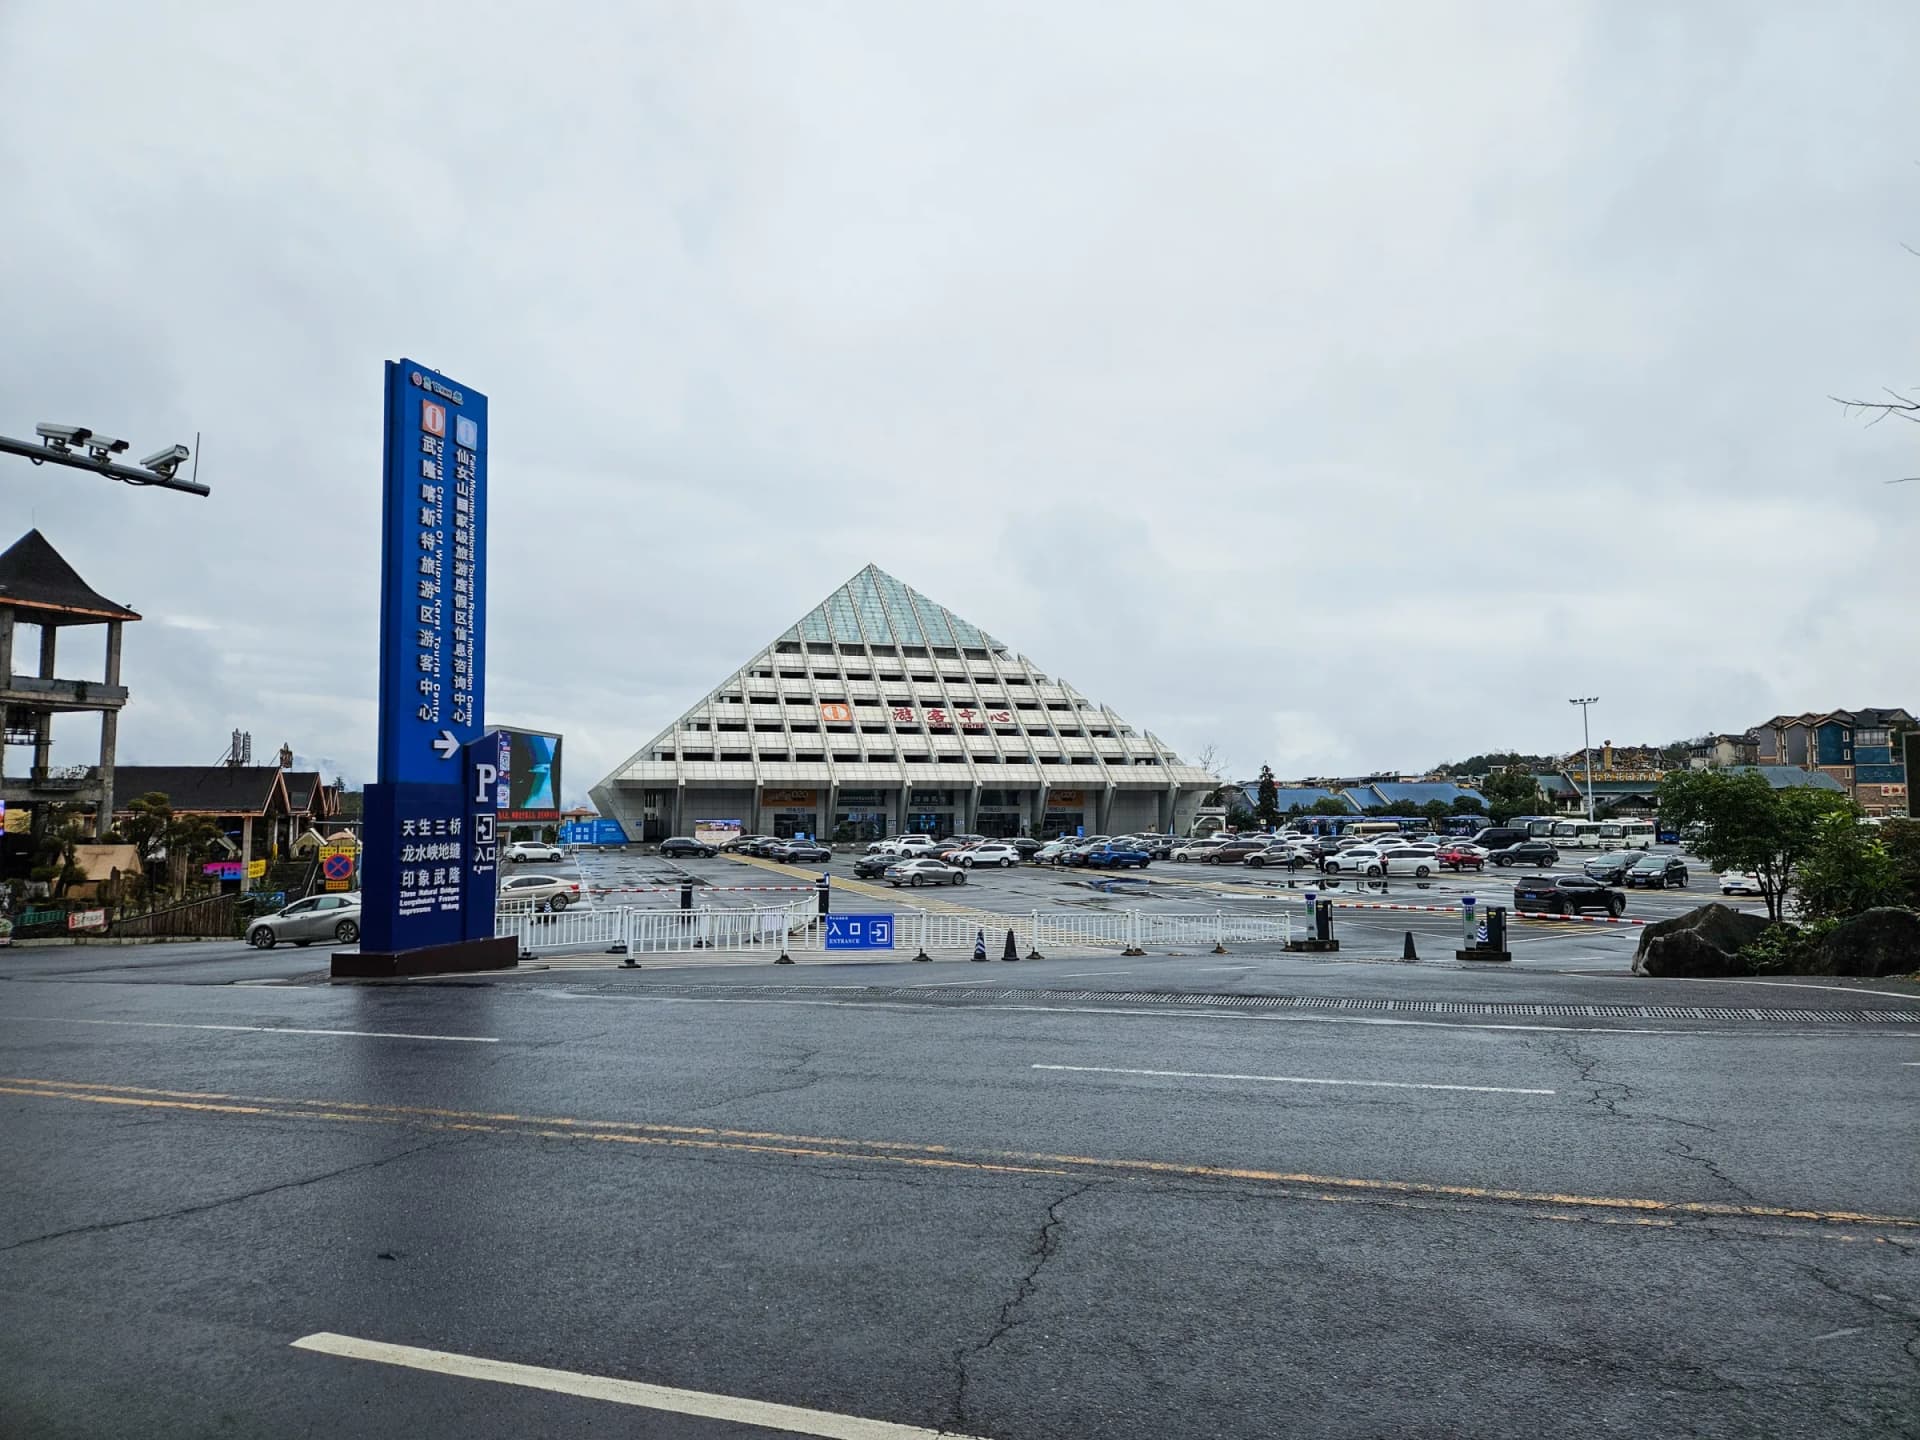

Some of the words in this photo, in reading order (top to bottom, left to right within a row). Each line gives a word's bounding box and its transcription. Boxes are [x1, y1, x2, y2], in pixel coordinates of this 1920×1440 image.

[436, 441, 444, 480] Tourist
[436, 486, 444, 525] Center
[468, 479, 476, 522] Mountain
[435, 549, 443, 593] Wulong
[467, 563, 475, 600] Tourism
[434, 599, 442, 630] Karst
[433, 636, 441, 677] Tourist
[466, 637, 474, 690] Information
[432, 683, 441, 723] Centre
[892, 707, 1010, 722] 游客中心
[475, 763, 497, 803] P
[403, 818, 461, 836] 天生三桥
[402, 842, 460, 862] 龙水峡地缝
[475, 847, 496, 862] 入口
[402, 866, 460, 888] 印象武隆
[829, 922, 860, 935] 入口
